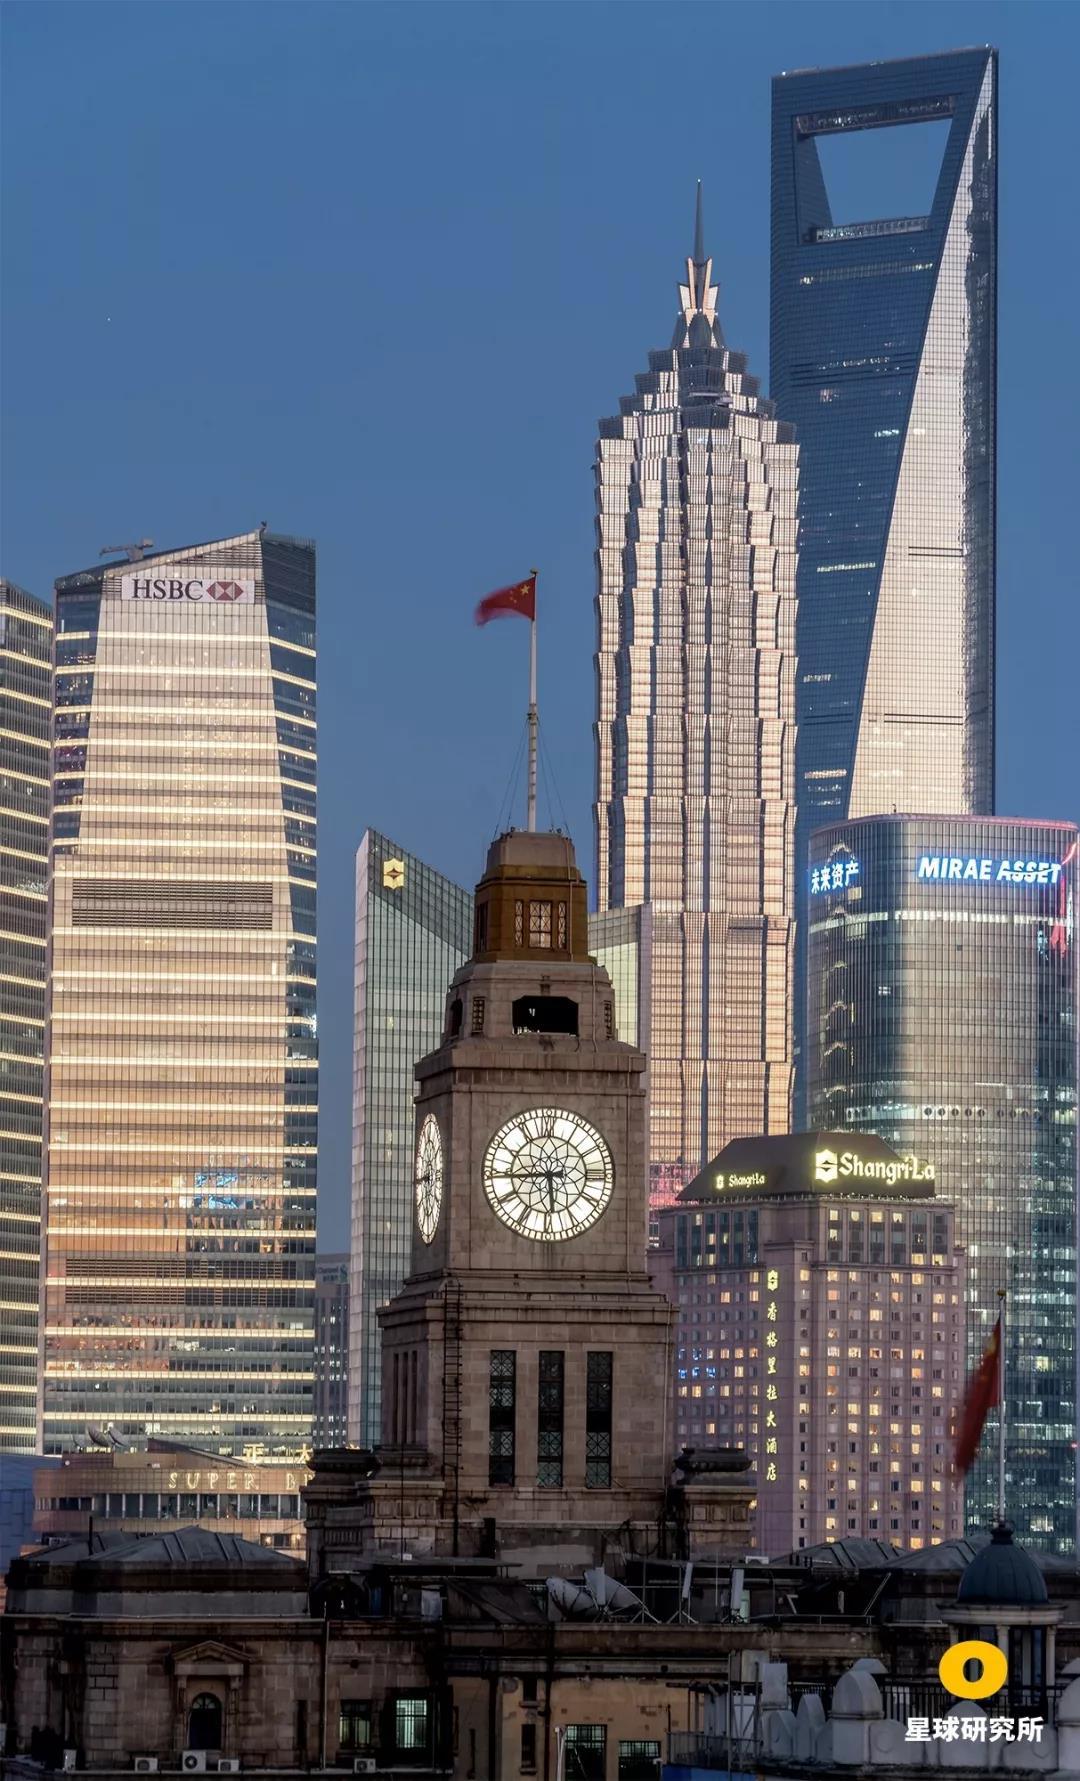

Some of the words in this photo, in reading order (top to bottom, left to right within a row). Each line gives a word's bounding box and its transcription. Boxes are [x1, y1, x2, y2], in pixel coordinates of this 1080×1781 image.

[132, 578, 203, 601] HSBC
[811, 860, 860, 894] 未来资产
[918, 857, 993, 879] MIRAE
[997, 860, 1061, 884] ASSET
[838, 1152, 936, 1185] Shangri-La
[766, 1301, 779, 1482] 香格里拉大酒店
[168, 1471, 260, 1491] SUPER
